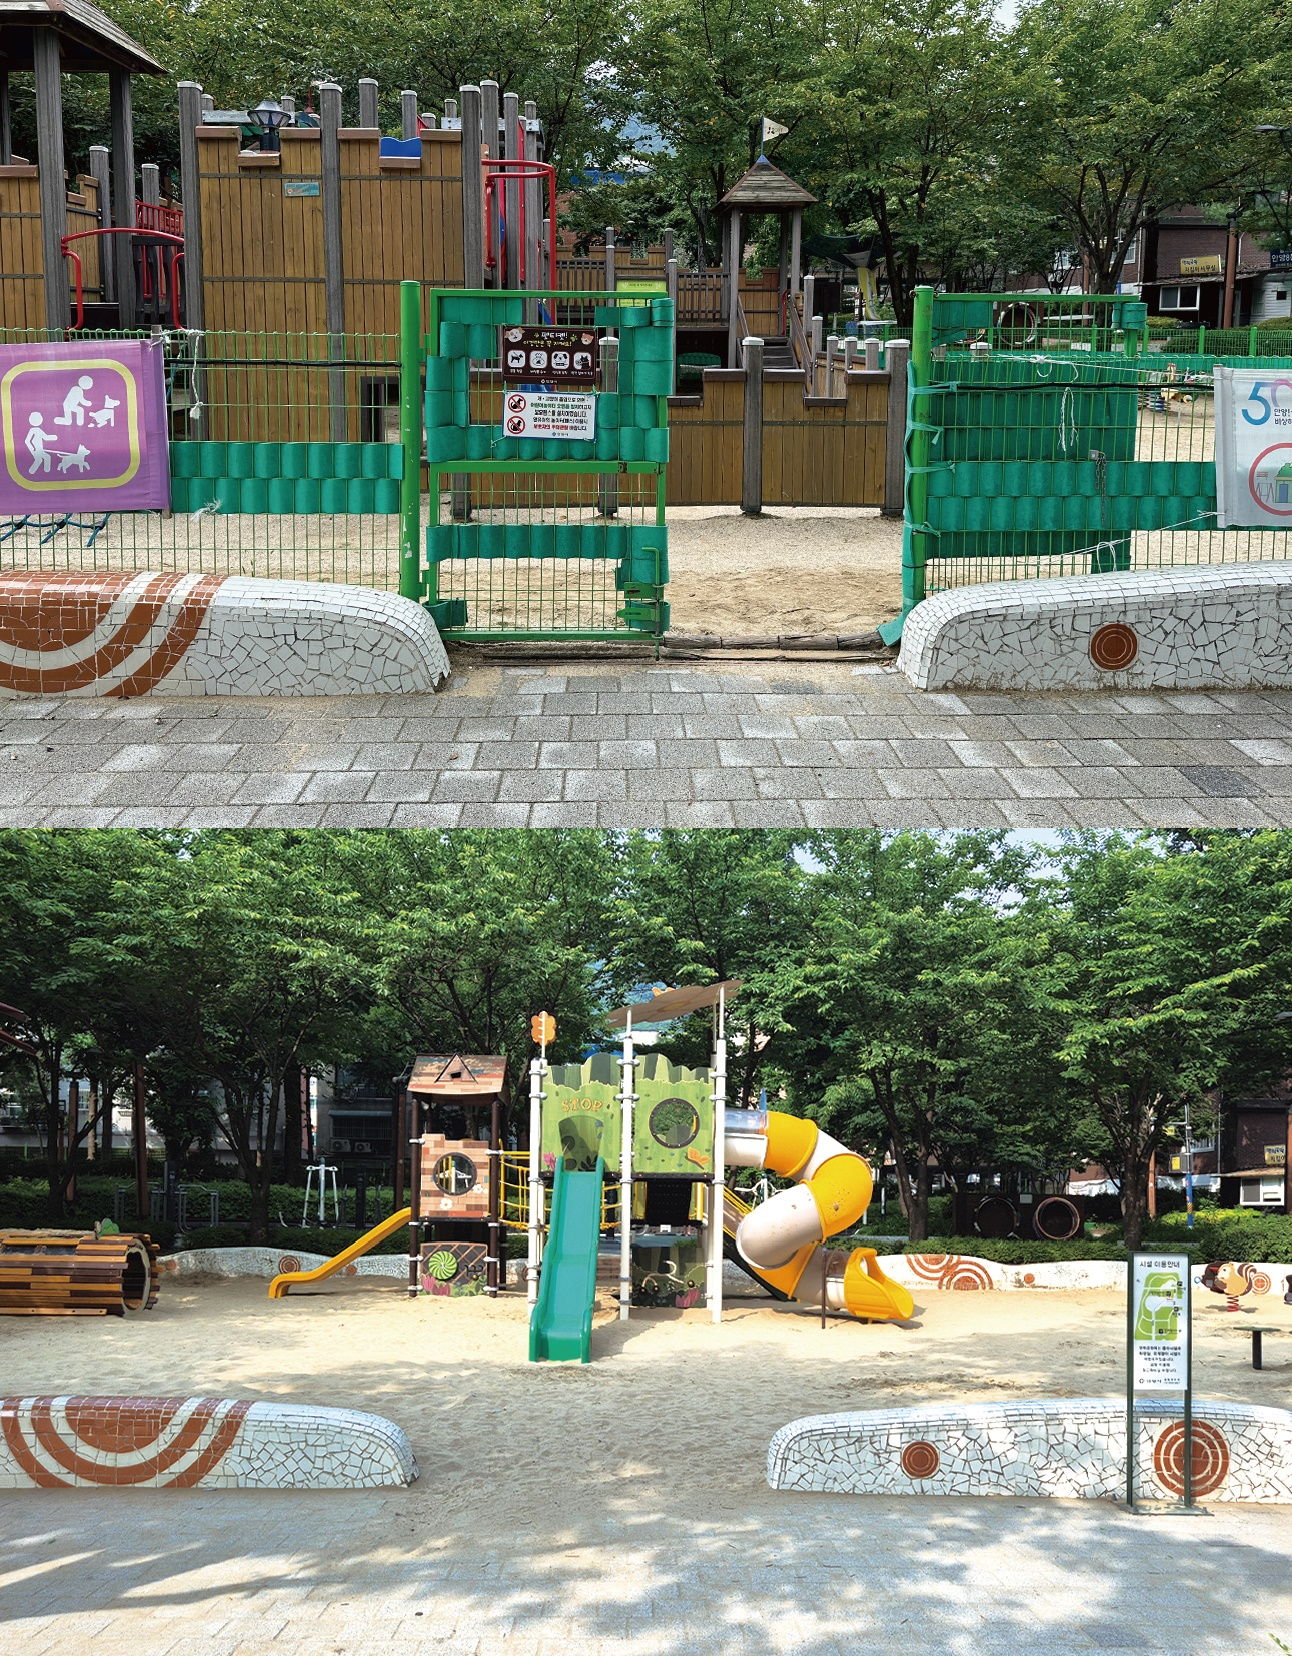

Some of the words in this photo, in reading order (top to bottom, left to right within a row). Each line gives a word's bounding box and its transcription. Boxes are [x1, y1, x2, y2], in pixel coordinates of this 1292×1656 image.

[1271, 254, 1292, 263] 안양8
[561, 1098, 603, 1112] STOP
[1140, 1260, 1153, 1268] 시설
[1154, 1260, 1180, 1268] 이용안내
